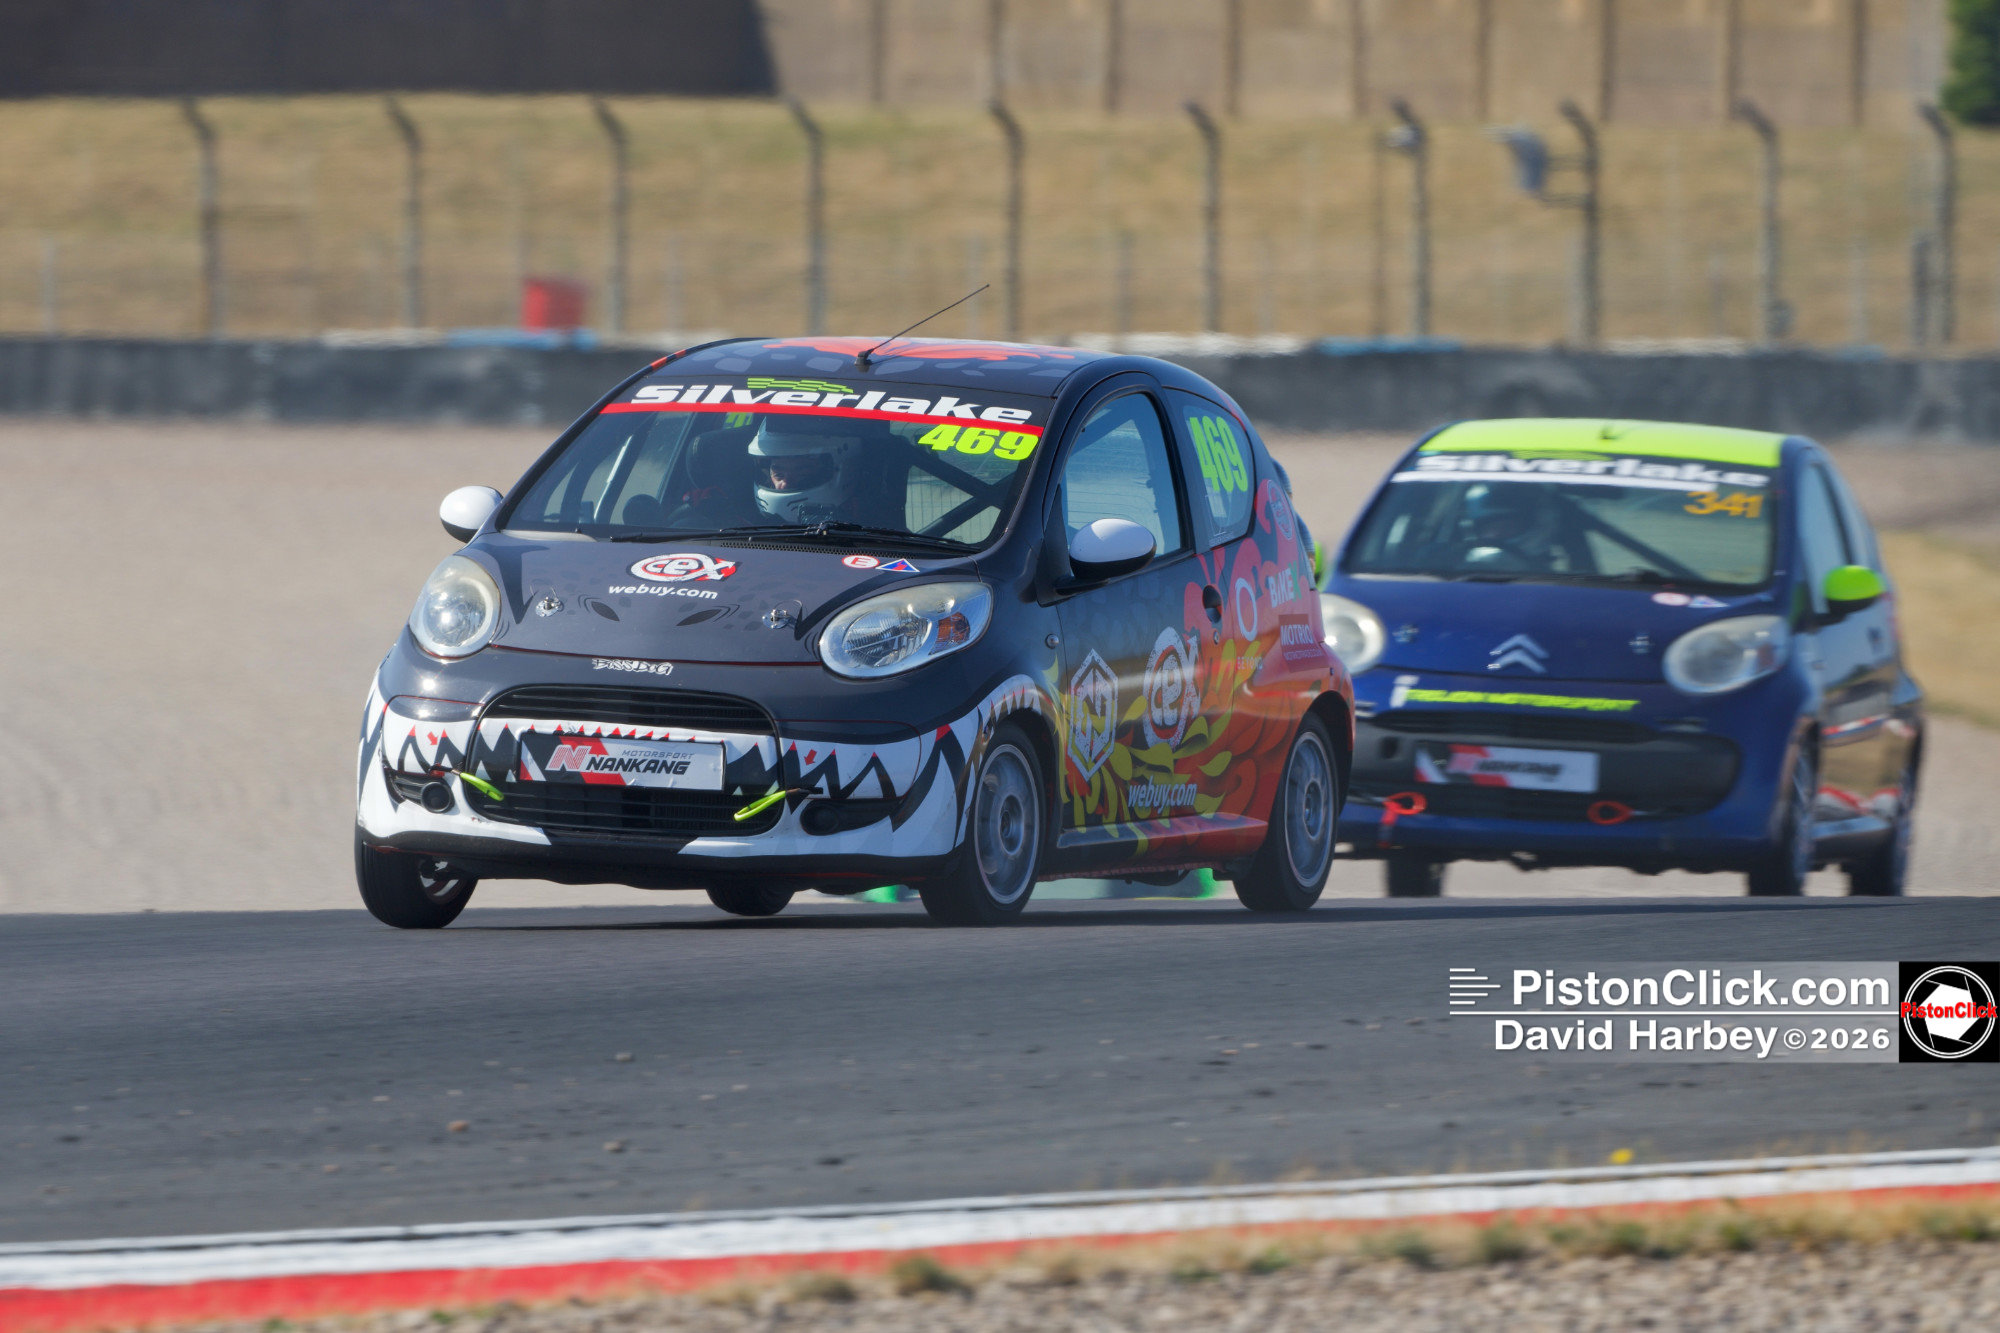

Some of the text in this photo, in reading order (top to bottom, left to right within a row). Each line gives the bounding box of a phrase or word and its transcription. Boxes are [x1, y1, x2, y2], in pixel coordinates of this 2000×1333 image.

[631, 384, 1033, 425] Silverlake
[918, 423, 1039, 461] 469
[1188, 415, 1248, 494] 469
[1415, 453, 1771, 487] Silverlake
[1683, 490, 1765, 519] 341
[850, 556, 871, 567] E
[608, 584, 719, 600] webuy.com
[585, 754, 691, 776] NANKANG
[621, 749, 695, 760] MOTORSPORT
[1127, 776, 1198, 814] webuy.com
